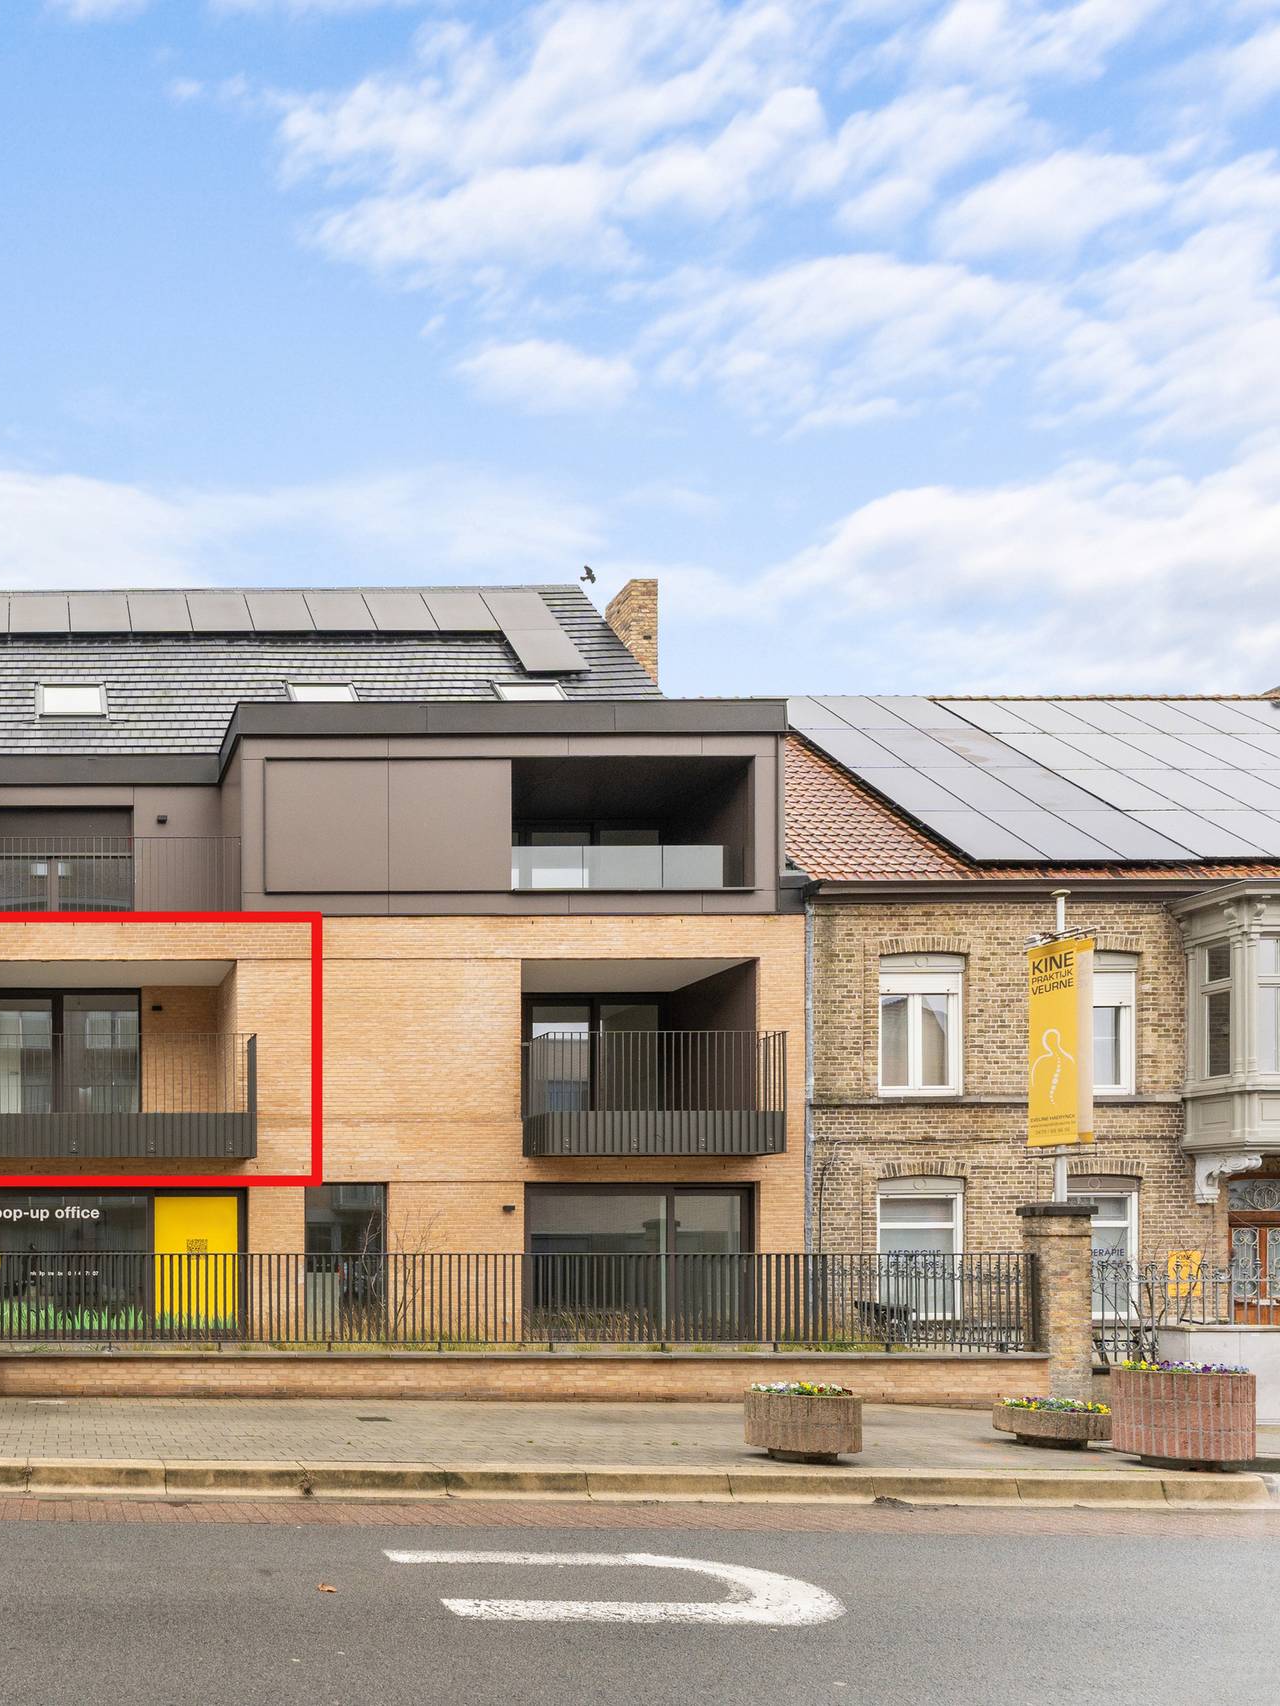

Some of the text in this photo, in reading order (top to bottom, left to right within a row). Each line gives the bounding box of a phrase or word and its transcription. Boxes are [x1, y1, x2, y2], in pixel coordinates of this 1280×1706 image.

[1032, 950, 1074, 976] KINE
[1031, 967, 1073, 985] PRAKTIJK
[1031, 978, 1074, 996] VEURNE
[55, 1206, 100, 1219] office
